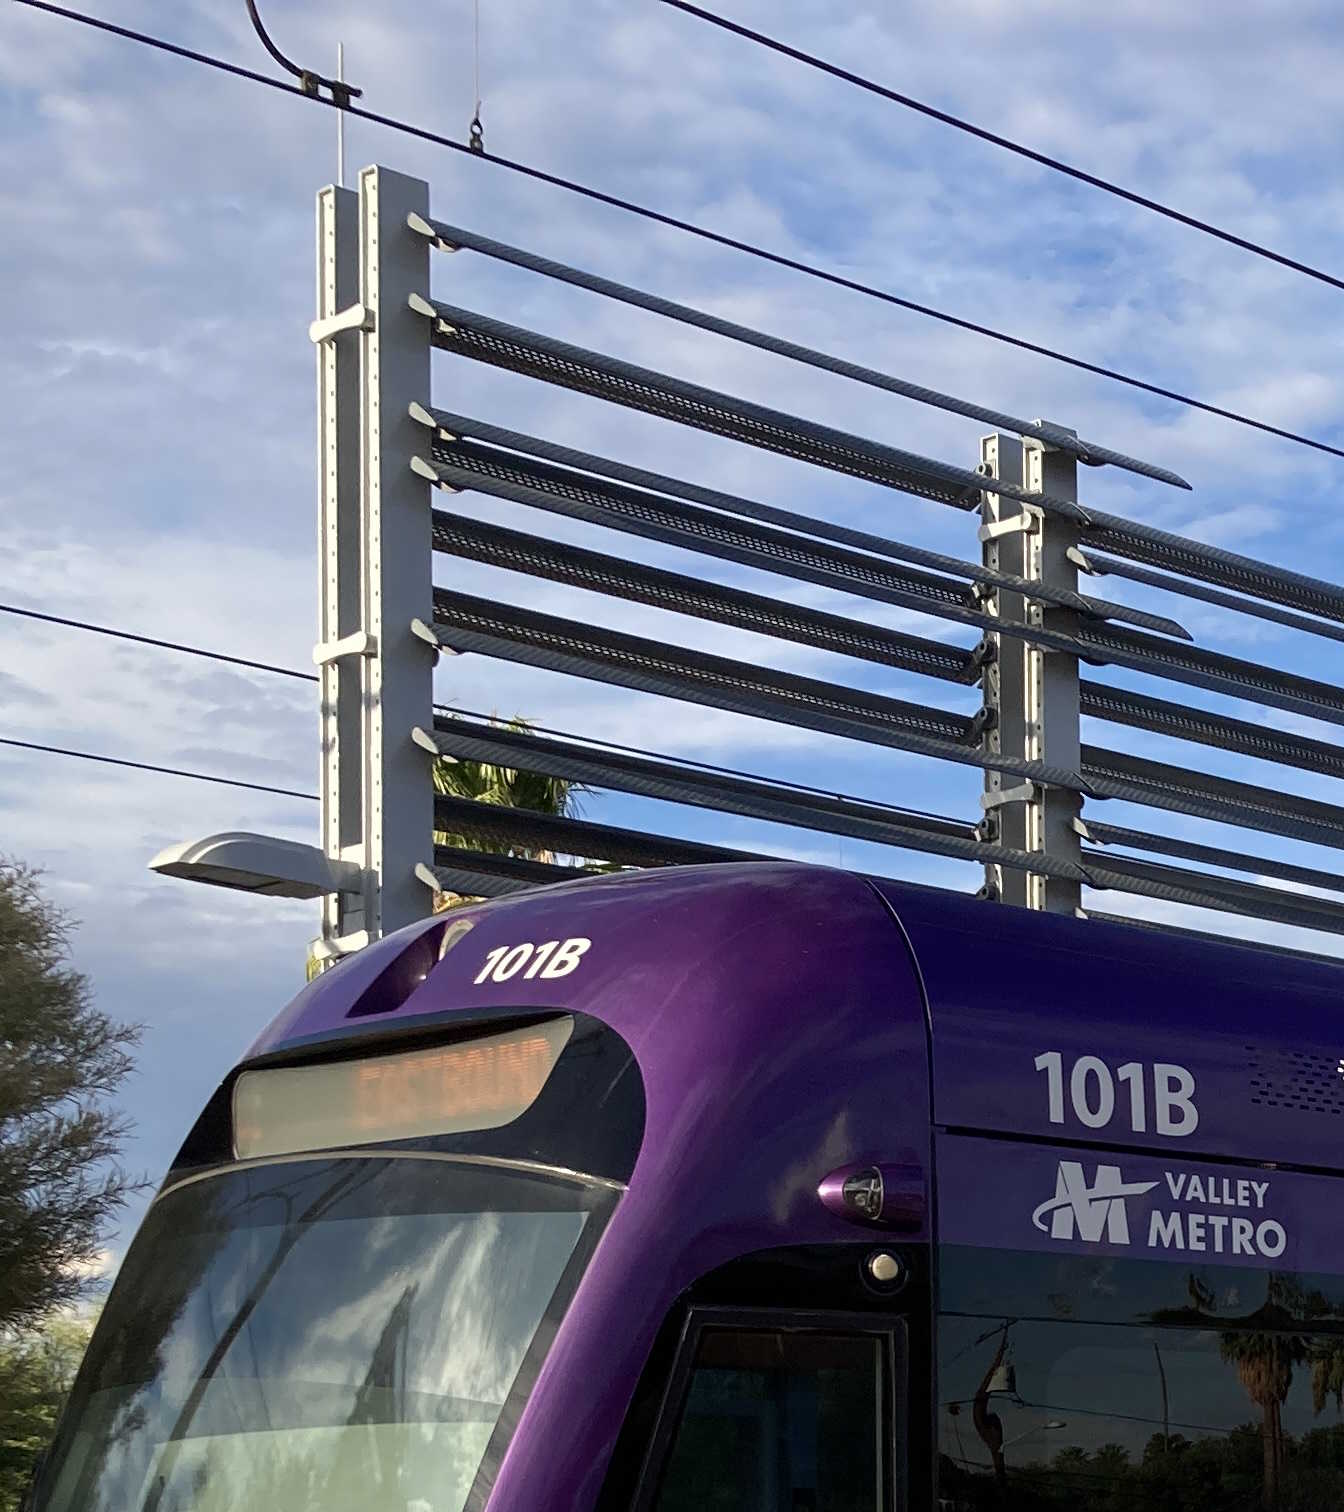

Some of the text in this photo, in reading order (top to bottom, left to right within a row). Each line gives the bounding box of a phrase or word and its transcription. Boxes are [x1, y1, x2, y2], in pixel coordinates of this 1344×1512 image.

[473, 937, 592, 985] 101B
[1033, 1050, 1199, 1137] 101B
[1164, 1171, 1271, 1209] VALLEY
[1147, 1210, 1287, 1259] METRO
